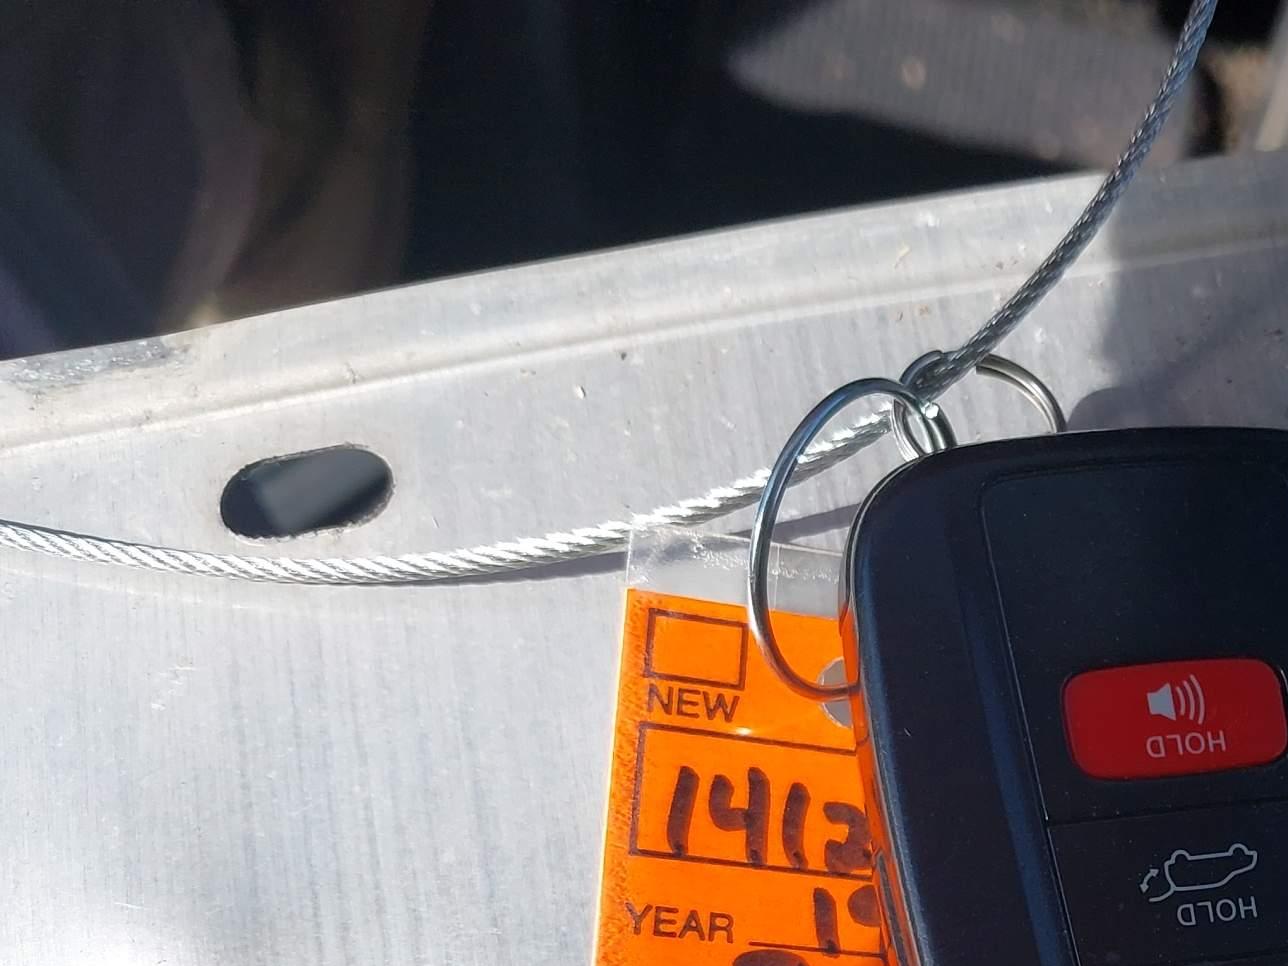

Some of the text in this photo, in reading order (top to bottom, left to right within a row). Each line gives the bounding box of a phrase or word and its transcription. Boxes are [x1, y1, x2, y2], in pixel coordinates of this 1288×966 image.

[648, 684, 740, 722] NEW
[1146, 730, 1226, 757] HOLD
[624, 901, 734, 944] YEAR
[1177, 896, 1257, 925] HOLD
